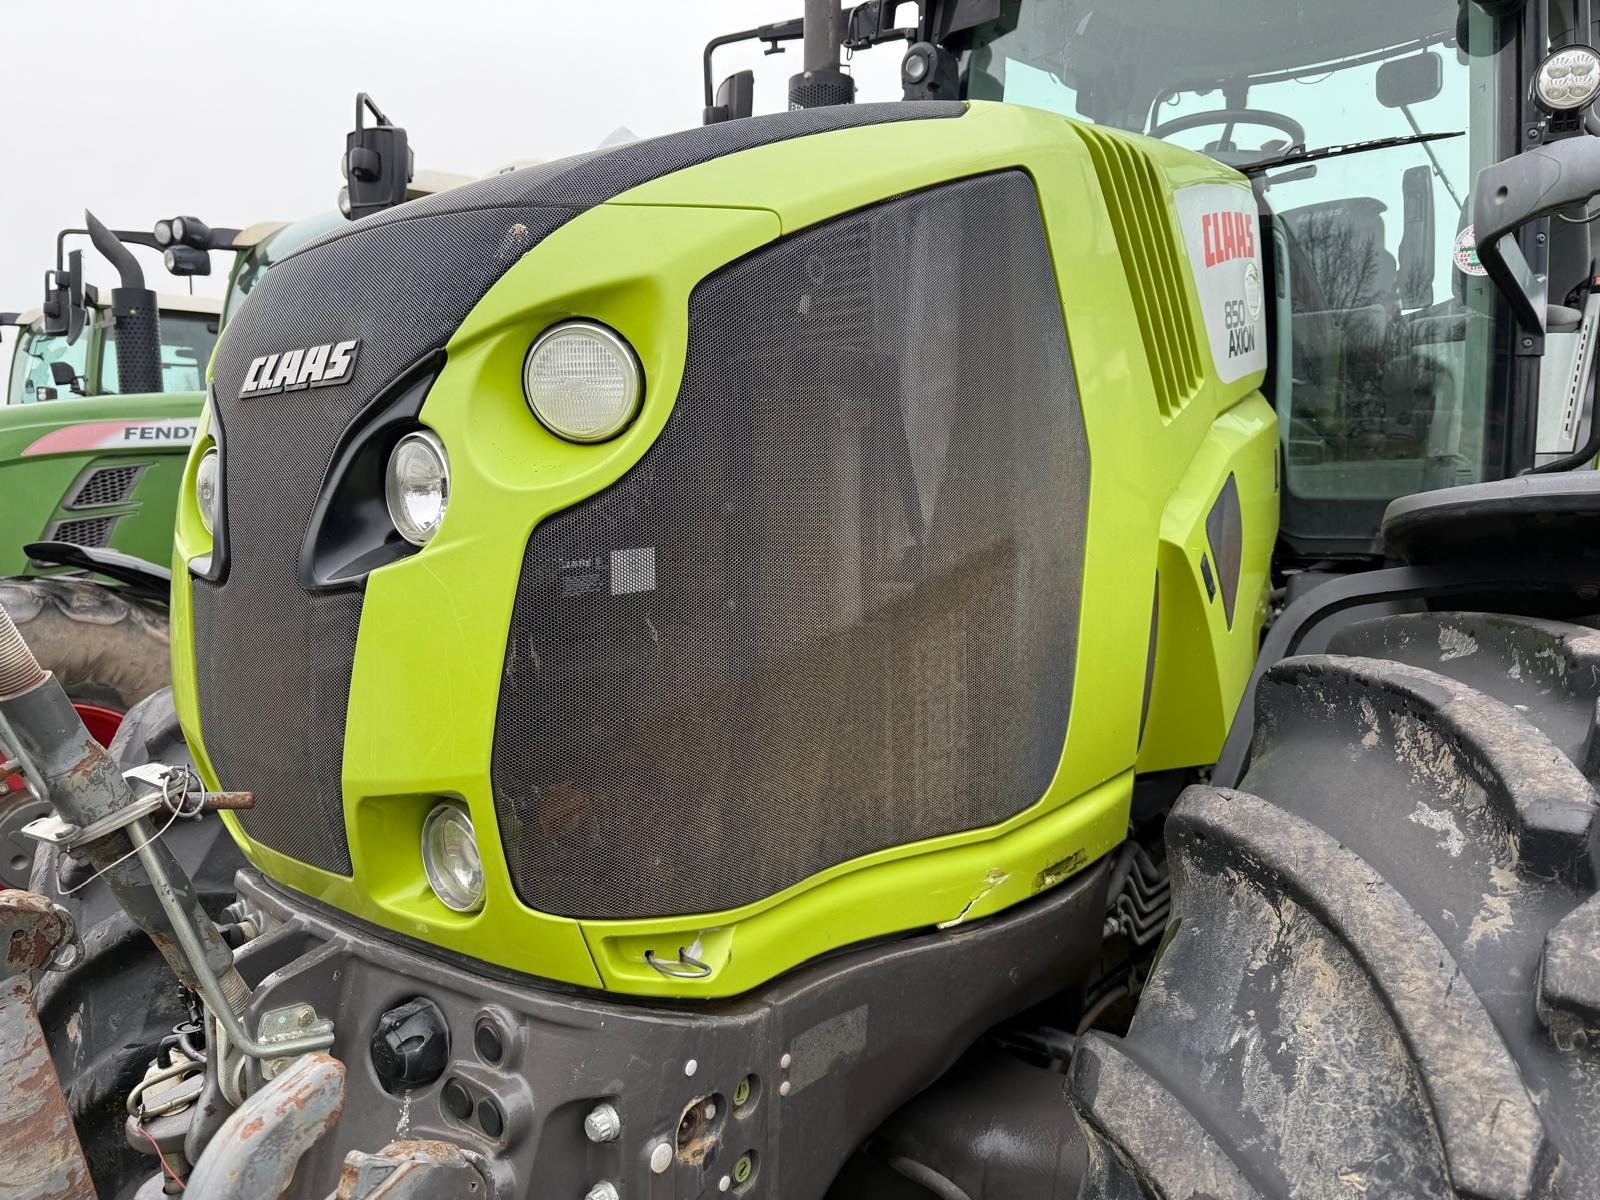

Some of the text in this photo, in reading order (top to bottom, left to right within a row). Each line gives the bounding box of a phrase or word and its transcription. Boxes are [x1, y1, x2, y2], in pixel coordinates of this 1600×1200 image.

[1202, 211, 1255, 268] CLAAS
[1225, 300, 1246, 329] 850
[1228, 325, 1255, 358] AXION
[241, 340, 358, 394] CLAAS
